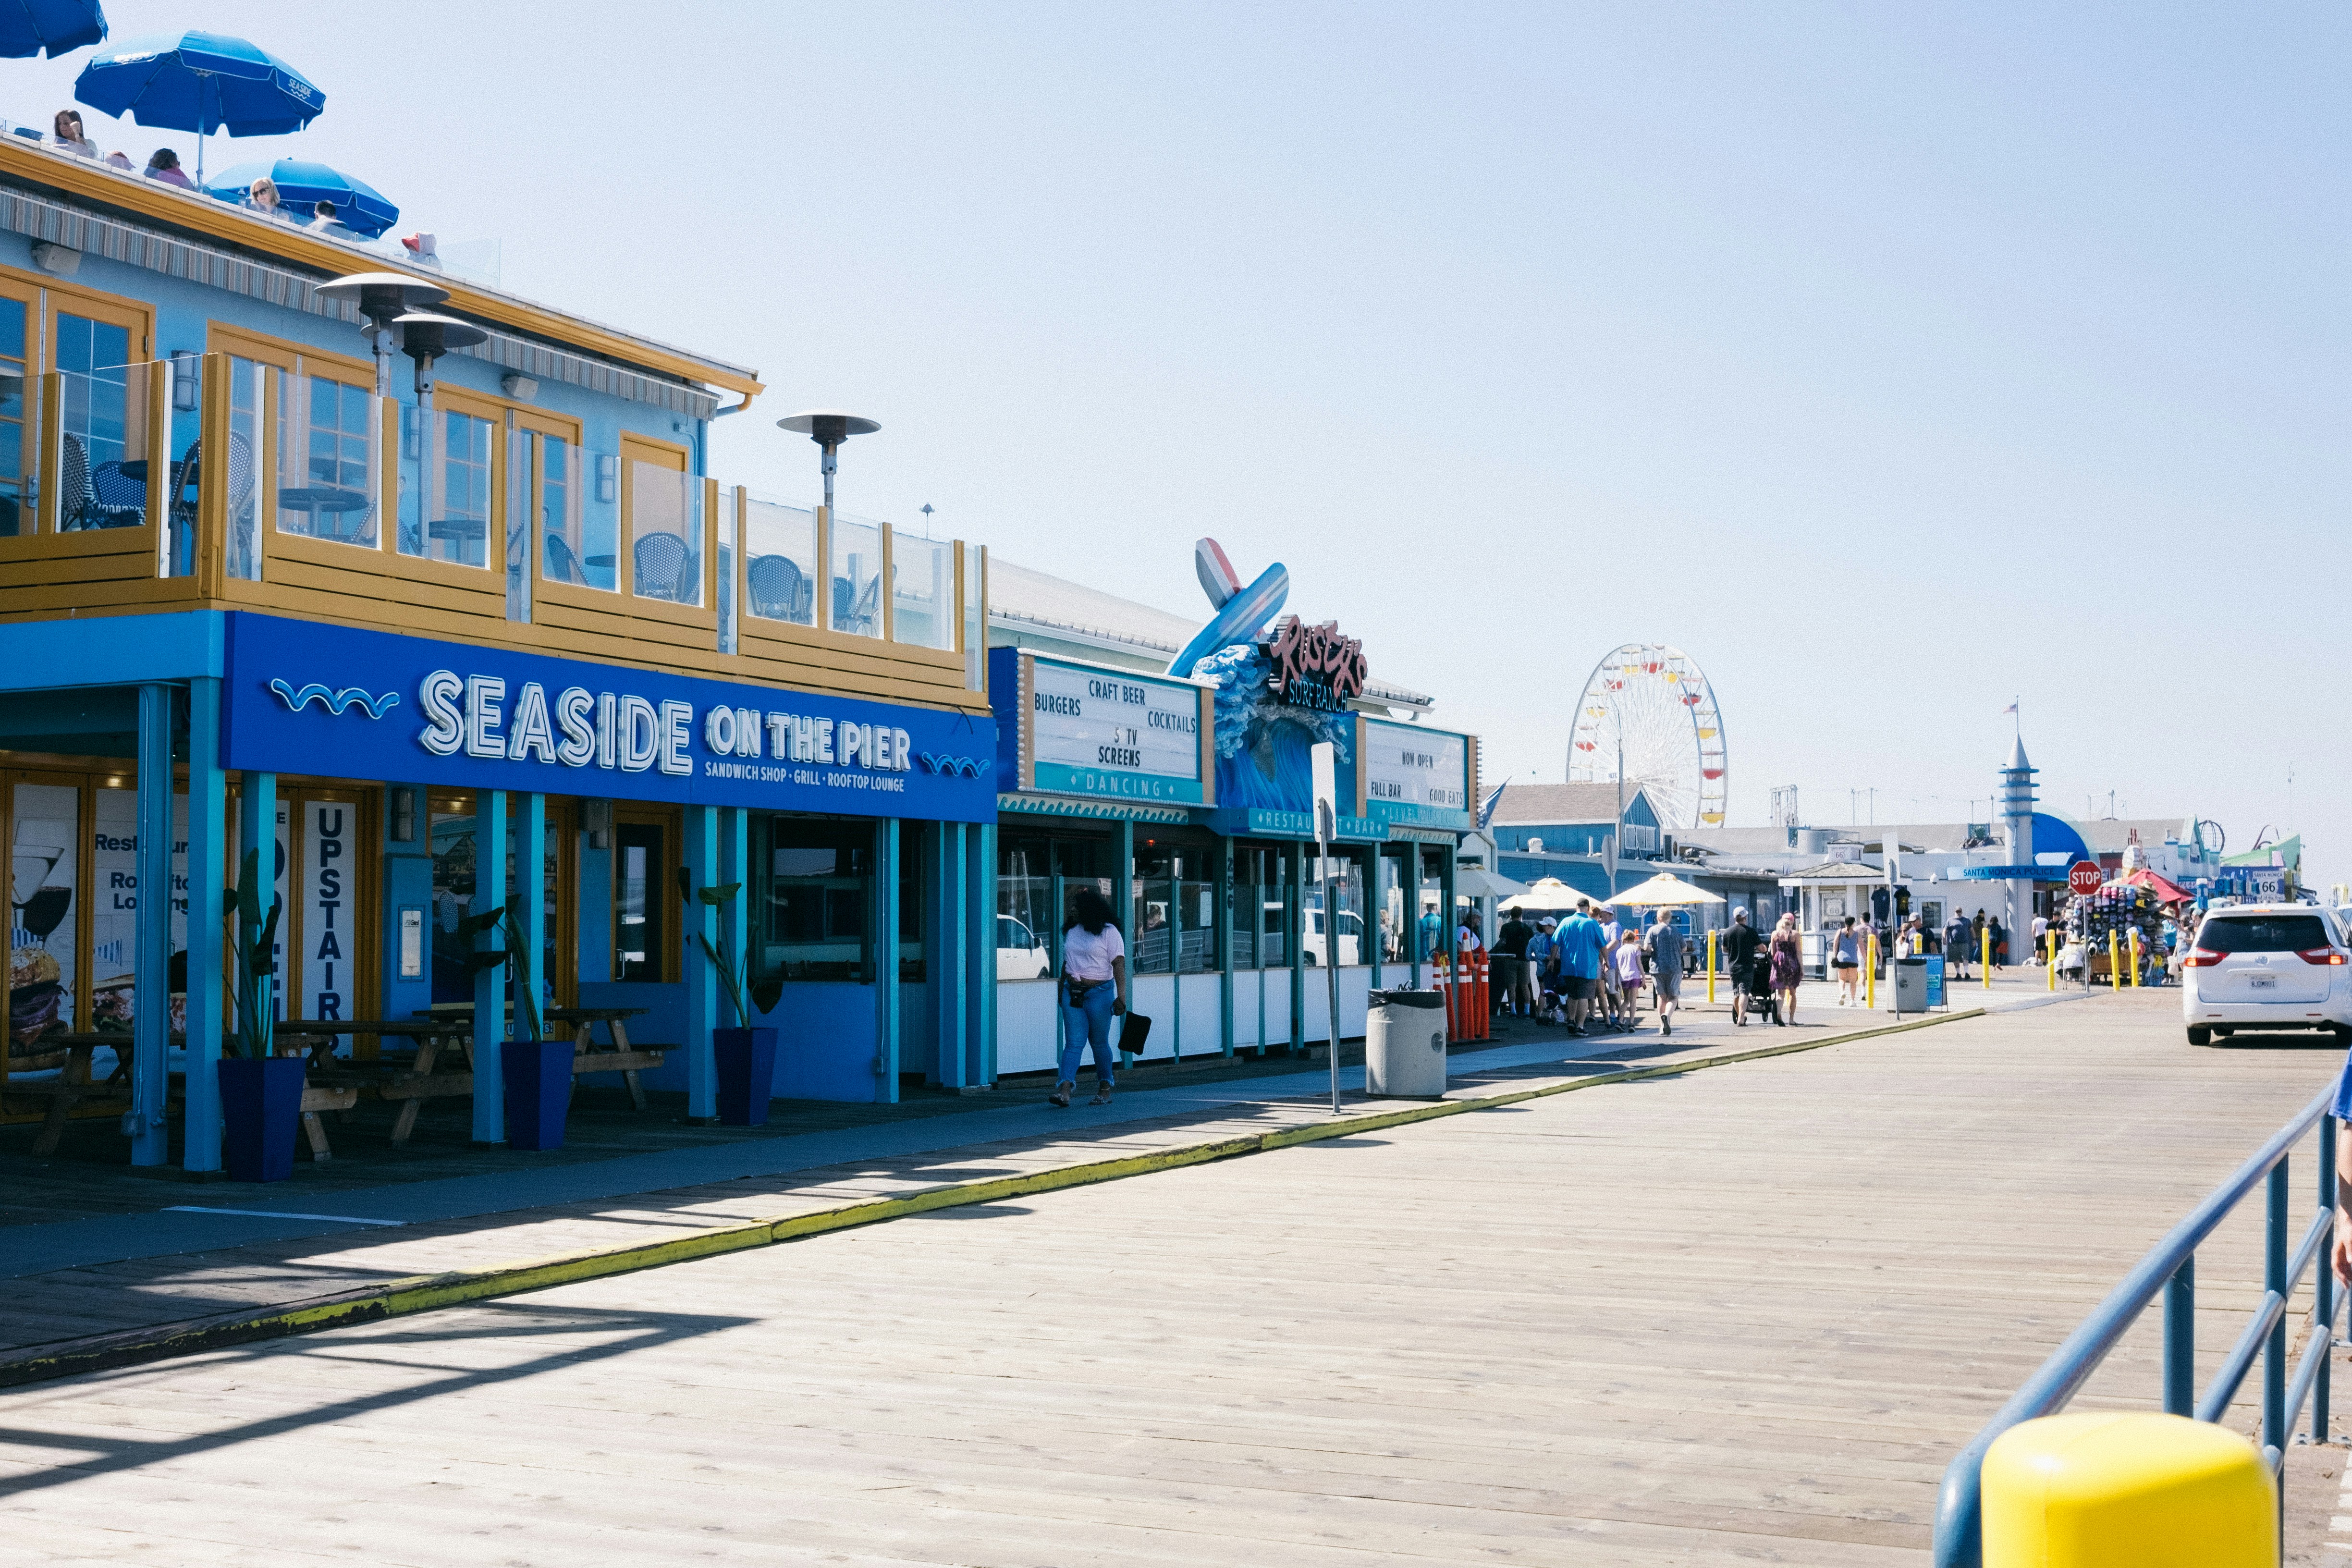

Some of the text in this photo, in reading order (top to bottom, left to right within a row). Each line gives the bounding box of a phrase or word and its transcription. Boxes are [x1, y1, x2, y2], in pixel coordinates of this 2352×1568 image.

[288, 78, 312, 97] SEASIDE
[1089, 679, 1145, 705] CRAFT BEER
[1289, 678, 1348, 713] SURF RANCH
[1034, 692, 1081, 716] BURGERS
[418, 669, 693, 776] SEASIDE
[1148, 710, 1196, 734] COCKTAILS
[705, 704, 911, 772] ON THE PIER
[1114, 726, 1137, 746] 5 TV
[1098, 746, 1140, 767] SCREENS
[1402, 751, 1433, 769] NOW OPEN
[704, 761, 904, 792] SANDWICH SHOP GRILL ROOFTOP LOUNGE
[1086, 774, 1160, 796] DANCING
[1371, 781, 1401, 798] FULL BAR
[1430, 788, 1463, 805] GOOD EATS
[1266, 812, 1374, 835] RESTAUT BAR
[1963, 869, 1985, 877] SANTA
[2024, 868, 2055, 876] POLICE
[2071, 871, 2101, 886] STOP
[2262, 881, 2276, 893] 66
